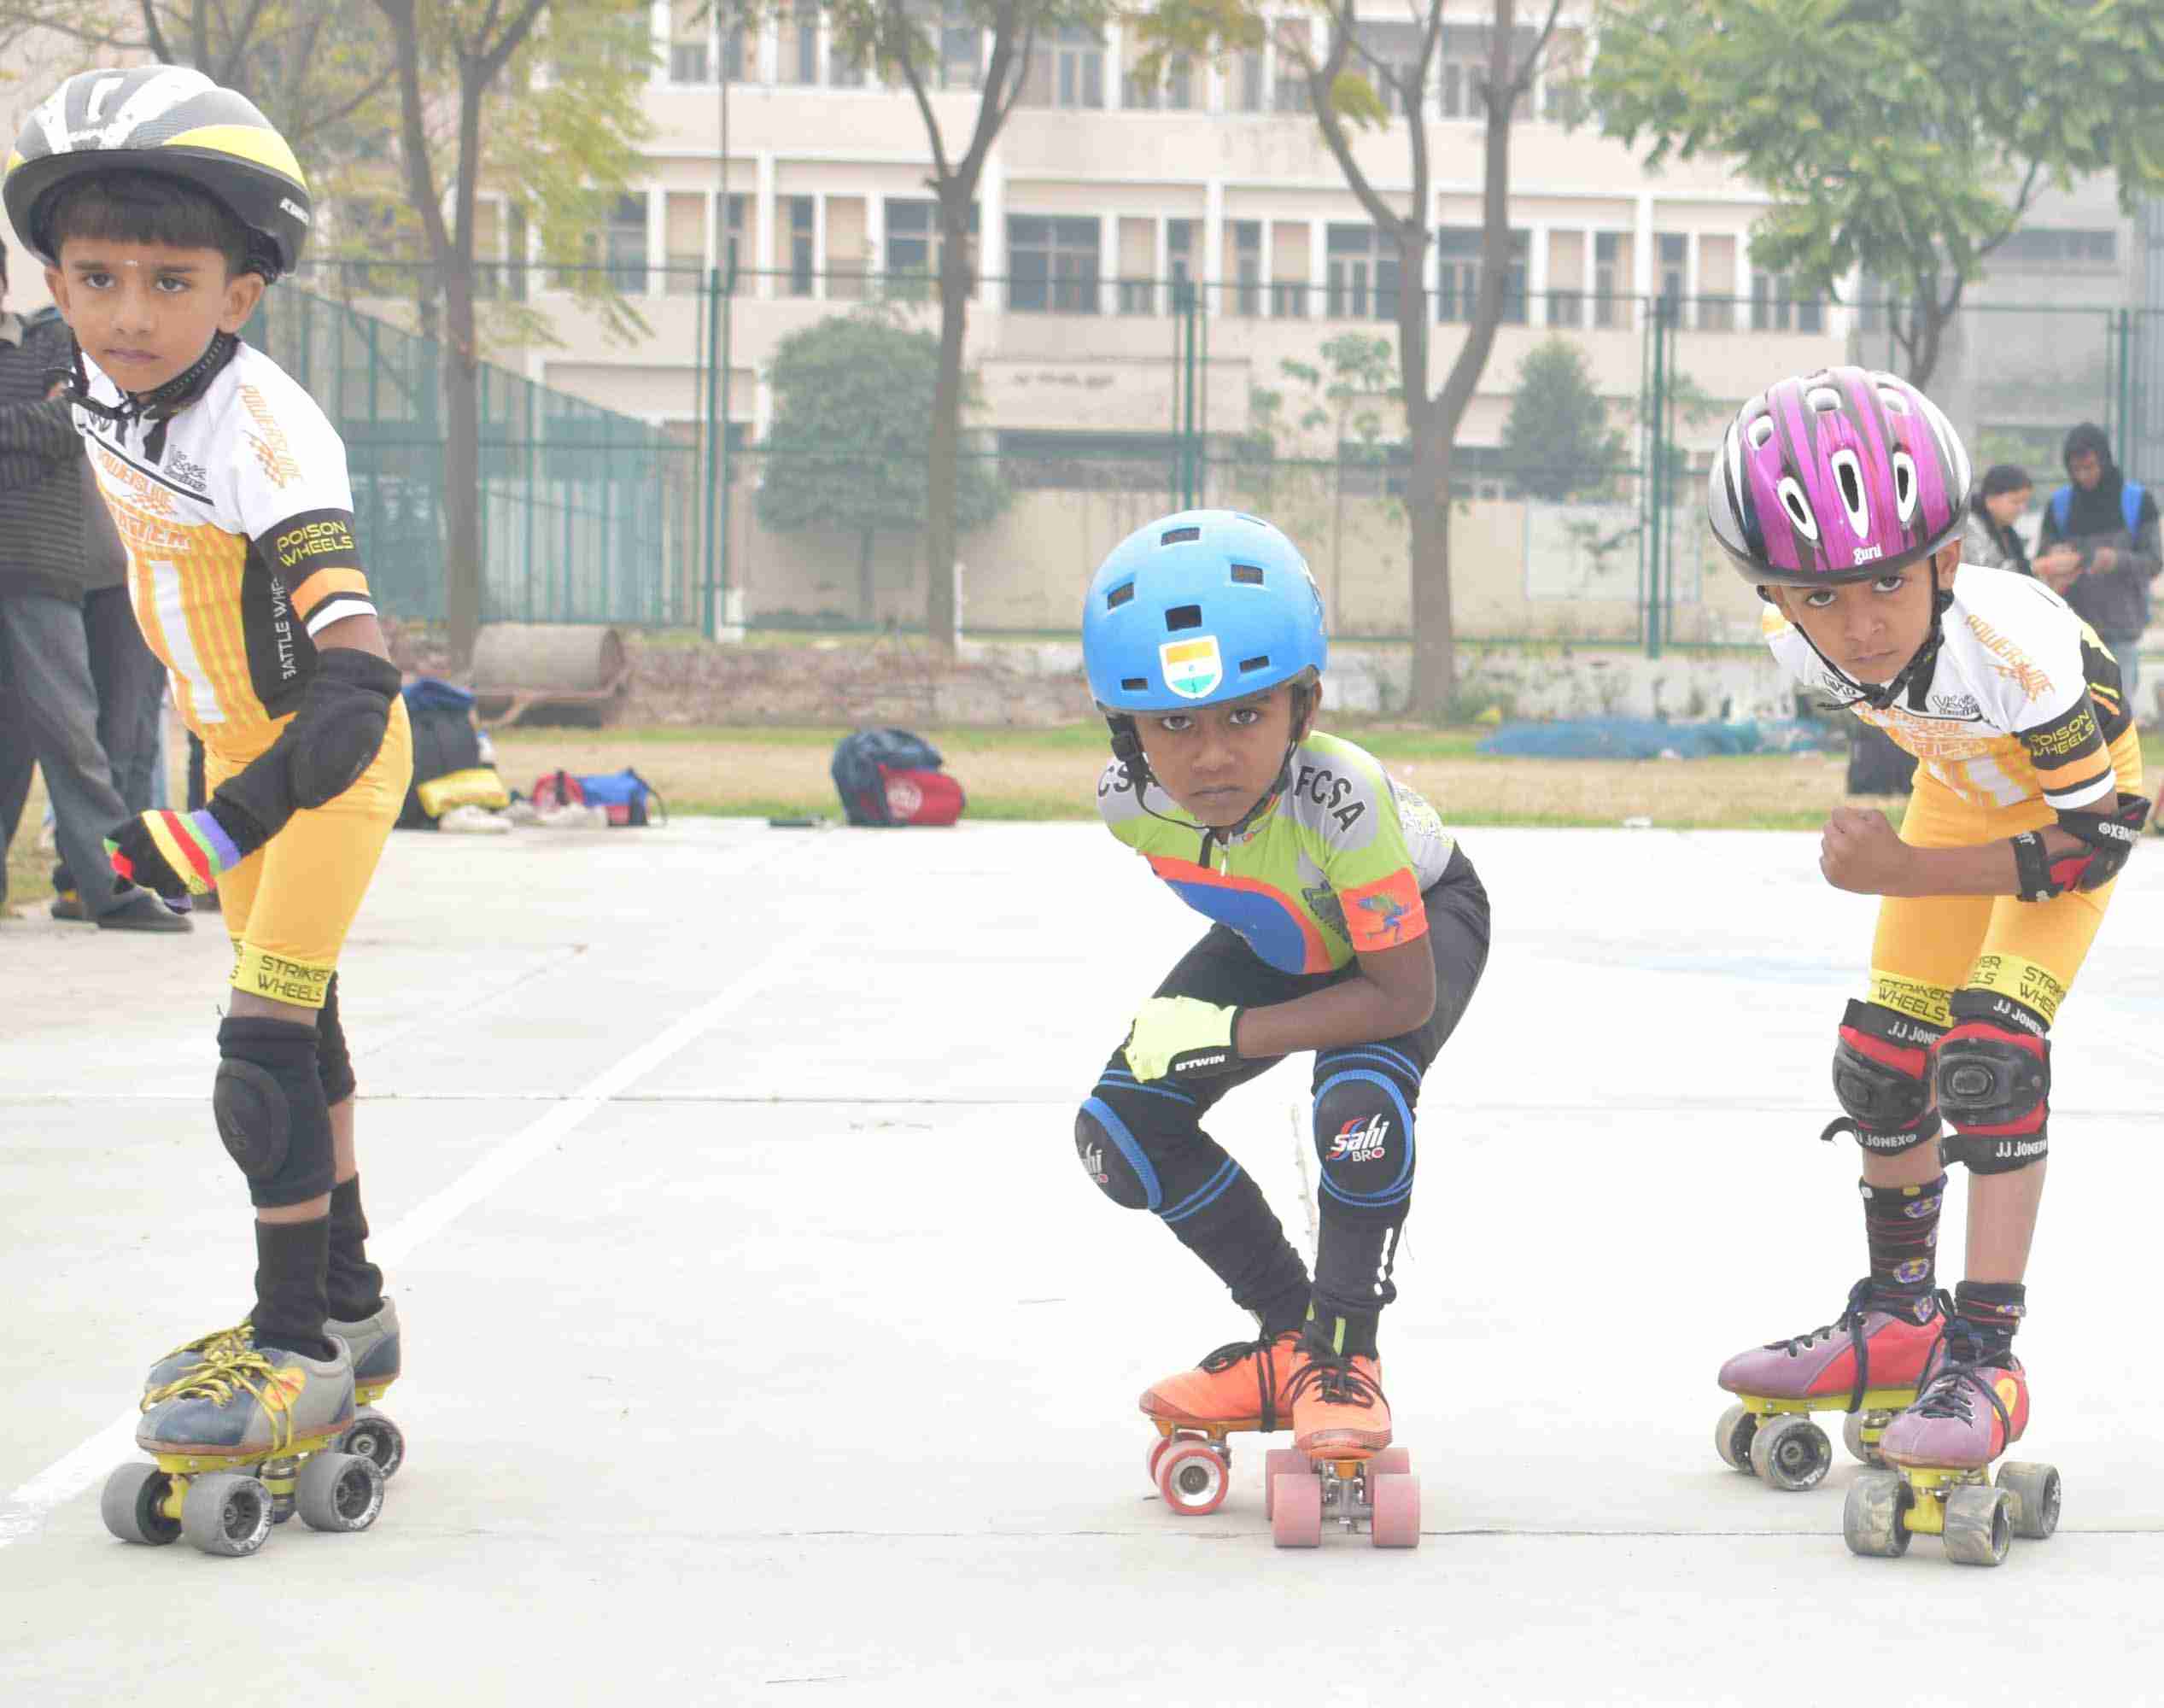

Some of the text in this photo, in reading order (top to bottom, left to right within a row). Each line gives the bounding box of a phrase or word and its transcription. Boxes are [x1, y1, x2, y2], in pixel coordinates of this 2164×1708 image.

[277, 519, 348, 552] POISON
[279, 535, 355, 567] WHEELS
[1853, 543, 1883, 565] guru
[1294, 766, 1366, 833] FCSA
[1879, 986, 1946, 1021] WHEELS
[1994, 998, 2011, 1014] JJ
[1888, 1021, 1908, 1038] JJ
[1331, 1114, 1389, 1150] sahi
[1353, 1147, 1384, 1161] BRO
[1996, 1141, 2012, 1157] JJ
